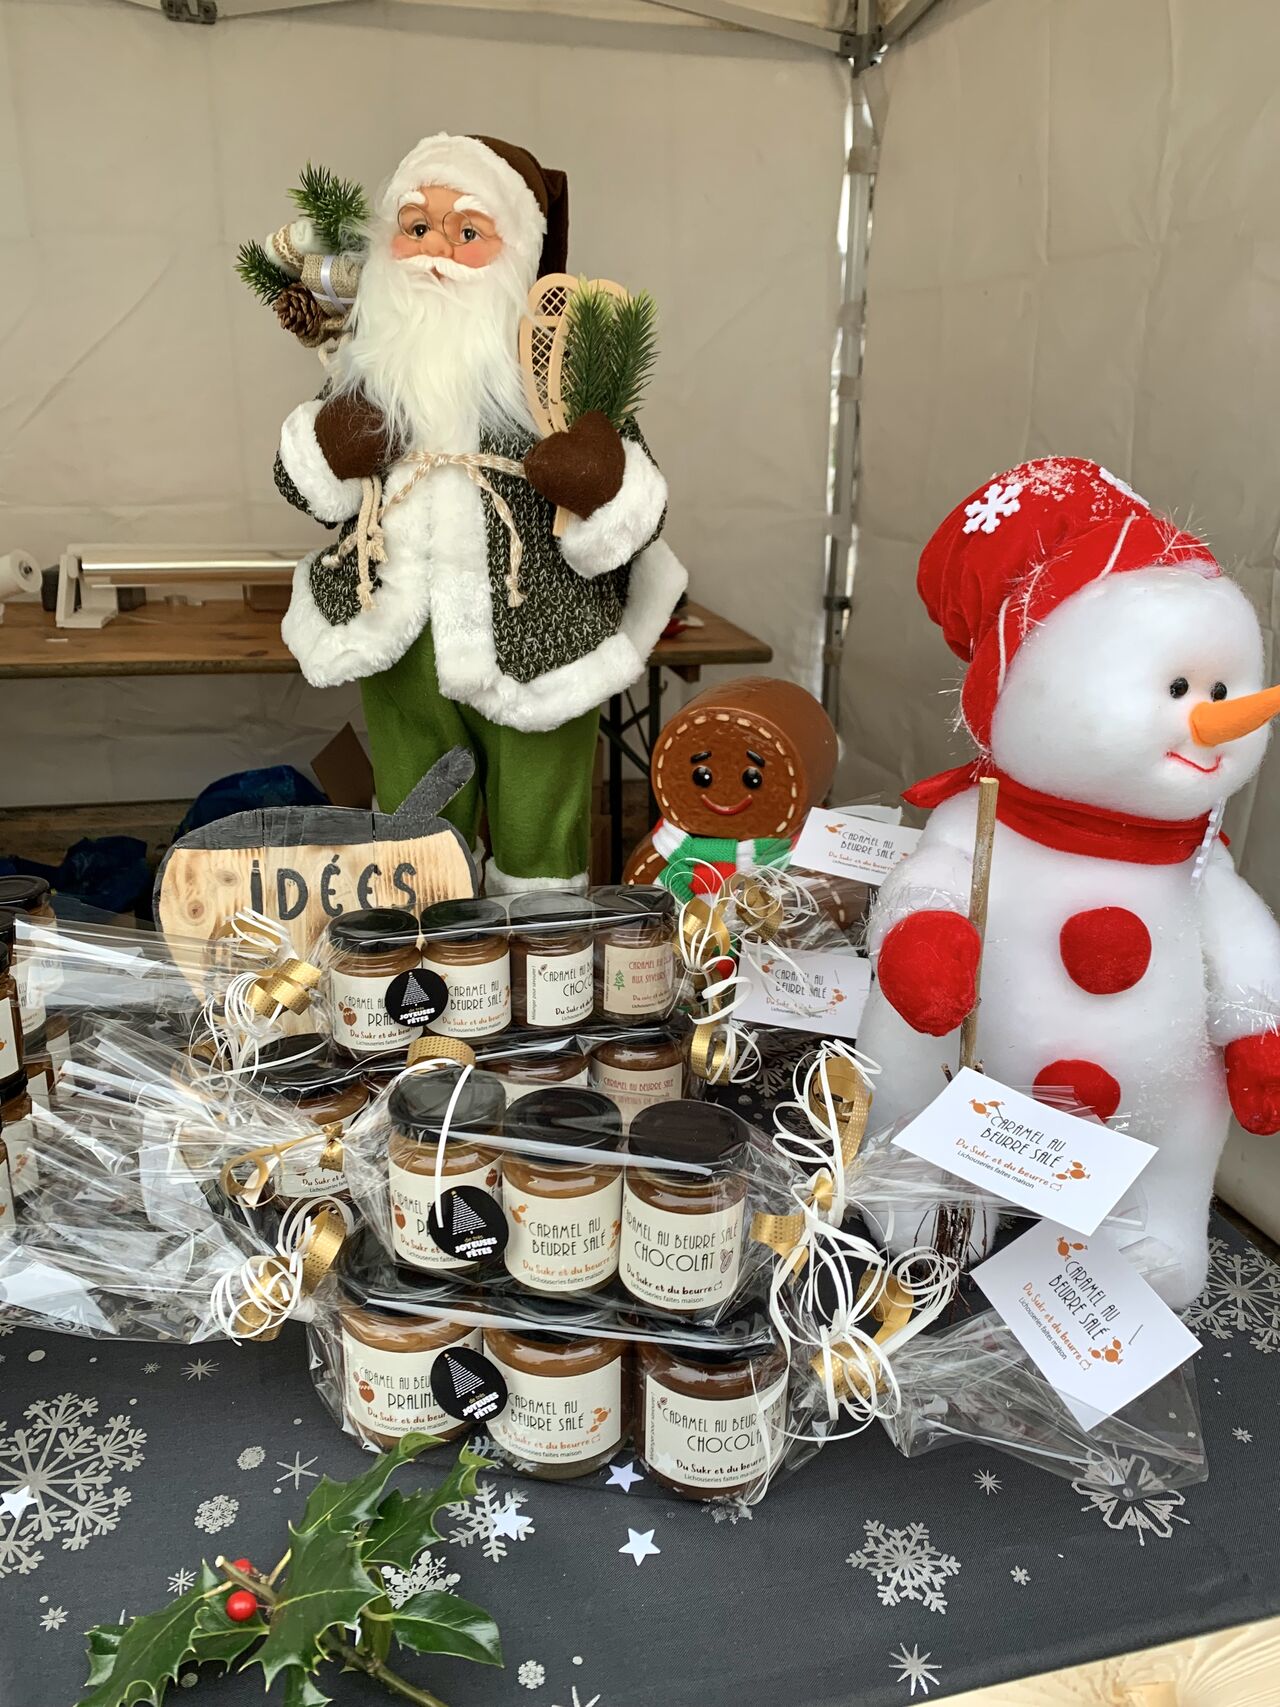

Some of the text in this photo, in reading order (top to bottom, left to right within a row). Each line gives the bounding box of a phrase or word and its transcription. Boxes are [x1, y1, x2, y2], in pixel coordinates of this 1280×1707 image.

[840, 841, 872, 856] BEURRE
[842, 832, 894, 850] CARAMEL AU
[542, 968, 576, 982] CARAMEL
[580, 964, 586, 978] AU
[814, 974, 824, 986] AU
[448, 980, 500, 997] CARAMEL AU
[344, 995, 374, 1010] CARAMEL
[450, 998, 484, 1010] BEURRE
[556, 1008, 565, 1016] Du
[566, 1004, 580, 1014] Sukr
[400, 1008, 436, 1020] JOYEUSES
[442, 1016, 451, 1024] Du
[453, 1017, 468, 1026] Sukr
[388, 1030, 397, 1038] du
[604, 1076, 628, 1090] CARAMEL
[640, 1082, 662, 1092] BEURRE
[990, 1116, 1066, 1152] CARAMEL AU
[980, 1128, 1064, 1168] BEURRE SALÉ
[956, 1138, 1049, 1186] Du Sukr et du beurre
[957, 1150, 1034, 1189] Lichouseries faites maison
[302, 1178, 312, 1186] Du
[314, 1178, 330, 1186] Sukr
[528, 1216, 600, 1238] CARAMEL AU
[455, 1237, 498, 1253] JOYEUSES
[532, 1228, 606, 1256] BEURRE SALÉ
[658, 1230, 670, 1246] AU
[674, 1232, 716, 1250] BEURRE
[466, 1246, 492, 1258] FÊTES
[634, 1240, 714, 1272] CHOCOLAT
[522, 1260, 534, 1271] Du
[536, 1264, 554, 1276] Sukr
[571, 1266, 583, 1275] du
[584, 1257, 610, 1272] beurre
[626, 1263, 712, 1295] Du Sukr et du beurre
[663, 1294, 680, 1304] faites
[1066, 1261, 1120, 1322] CARAMEL AU
[1048, 1274, 1110, 1340] BEURRE SALÉ
[1018, 1297, 1068, 1360] Lichouseries faites maison
[1023, 1282, 1082, 1360] Du Sukr et du beurre
[360, 1366, 394, 1390] CARAMEL
[400, 1376, 410, 1390] AU
[462, 1392, 500, 1416] JOYEUSES
[508, 1392, 578, 1416] CARAMEL AU
[368, 1407, 426, 1424] Du Sukr et du
[510, 1408, 584, 1432] BEURRE SALÉ
[662, 1408, 727, 1433] CARAMEL AU
[534, 1441, 544, 1449] et
[546, 1440, 558, 1450] du
[560, 1439, 590, 1449] beurre
[542, 1450, 560, 1458] faites
[676, 1460, 689, 1472] Du
[691, 1464, 711, 1474] Sukr
[714, 1467, 724, 1475] et
[726, 1464, 739, 1474] du
[684, 1474, 722, 1484] Lichouseries
[723, 1474, 739, 1482] faites
